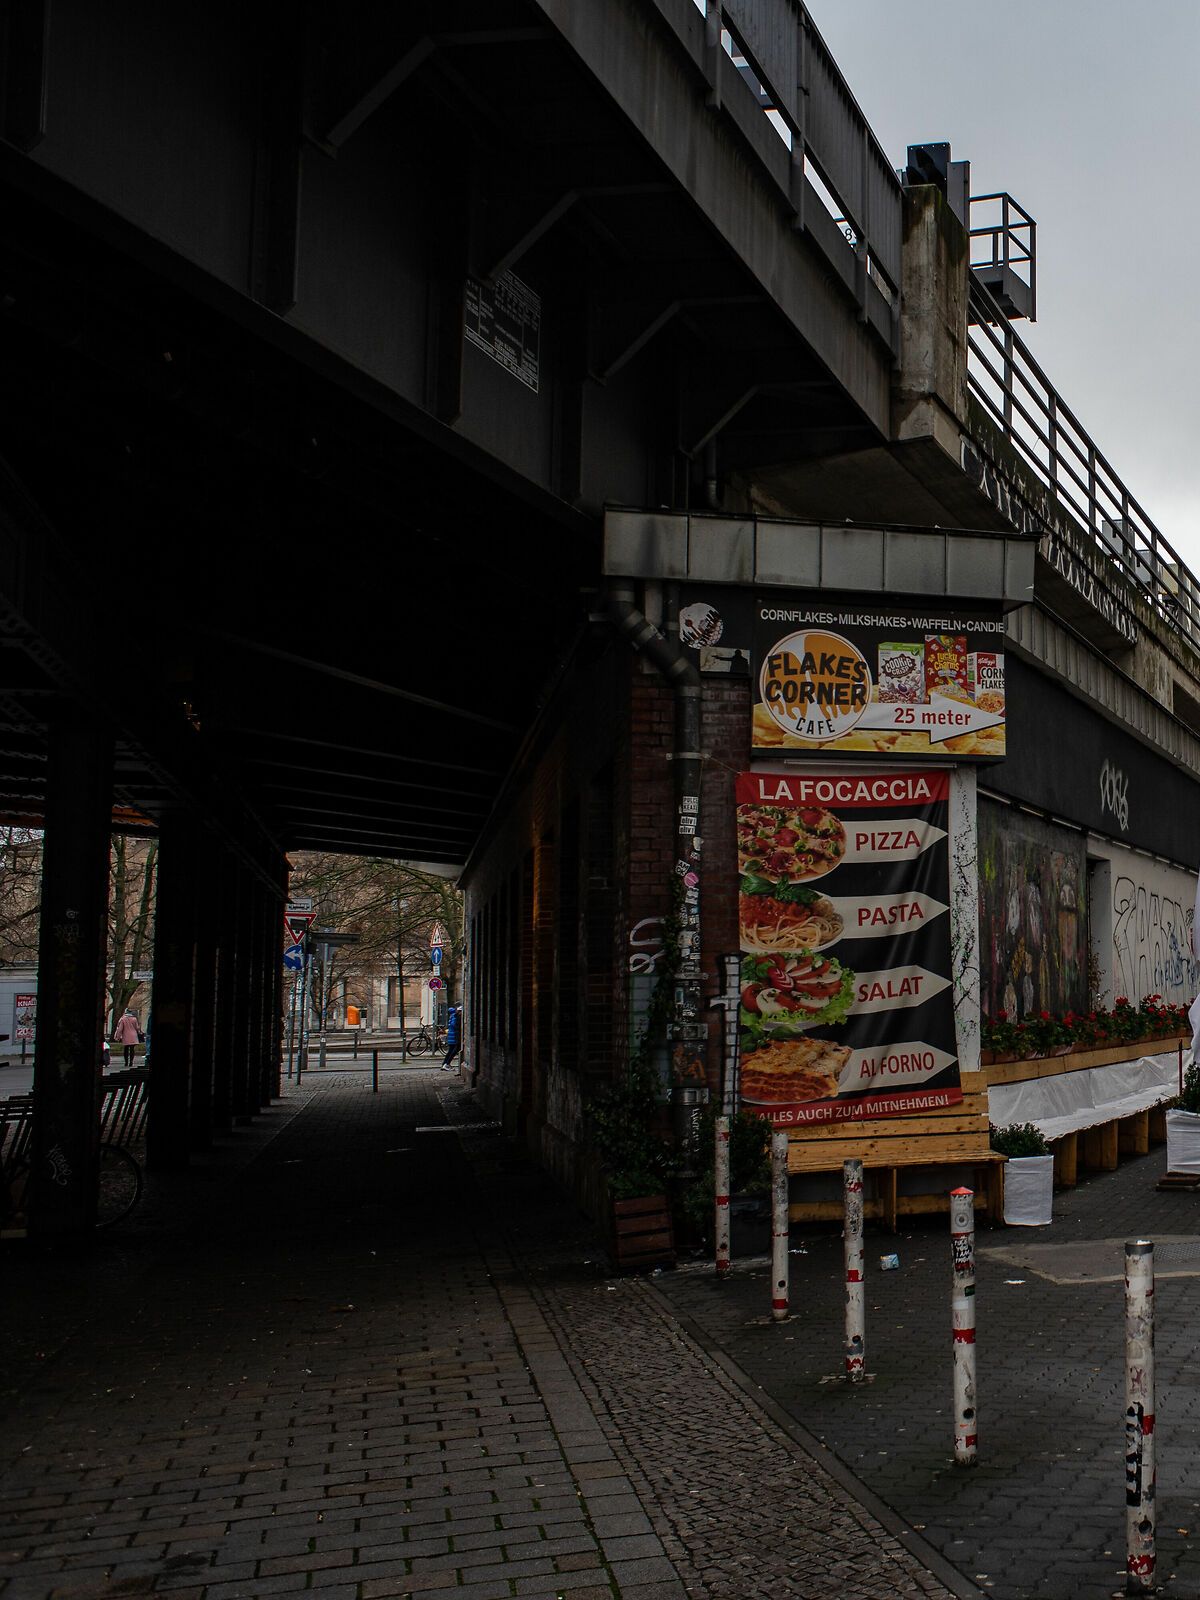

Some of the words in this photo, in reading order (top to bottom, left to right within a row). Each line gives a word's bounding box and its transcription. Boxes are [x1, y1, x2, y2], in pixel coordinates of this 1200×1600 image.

[760, 608, 834, 624] CORNFLAKES
[838, 613, 907, 628] MILKSHAKES
[912, 617, 961, 631] WAFFELN
[966, 620, 1004, 633] CANDIE
[767, 651, 867, 683] FLAKES
[980, 666, 1004, 680] CORN
[765, 679, 867, 706] CORNER
[981, 679, 1005, 690] FLAKES
[795, 717, 836, 735] CAFE
[894, 707, 915, 724] 25
[922, 709, 971, 726] meter
[758, 778, 794, 801] LA
[800, 778, 931, 802] FOCACCIA
[855, 830, 921, 851] PIZZA
[858, 902, 924, 926] PASTA
[857, 976, 924, 1003] SALAT
[859, 1058, 877, 1078] AL
[880, 1052, 935, 1075] FORNO
[758, 1110, 794, 1123] ALLES
[797, 1107, 832, 1121] AUCH
[836, 1104, 863, 1118] ZUM
[866, 1094, 950, 1115] MITNEHMEN!
